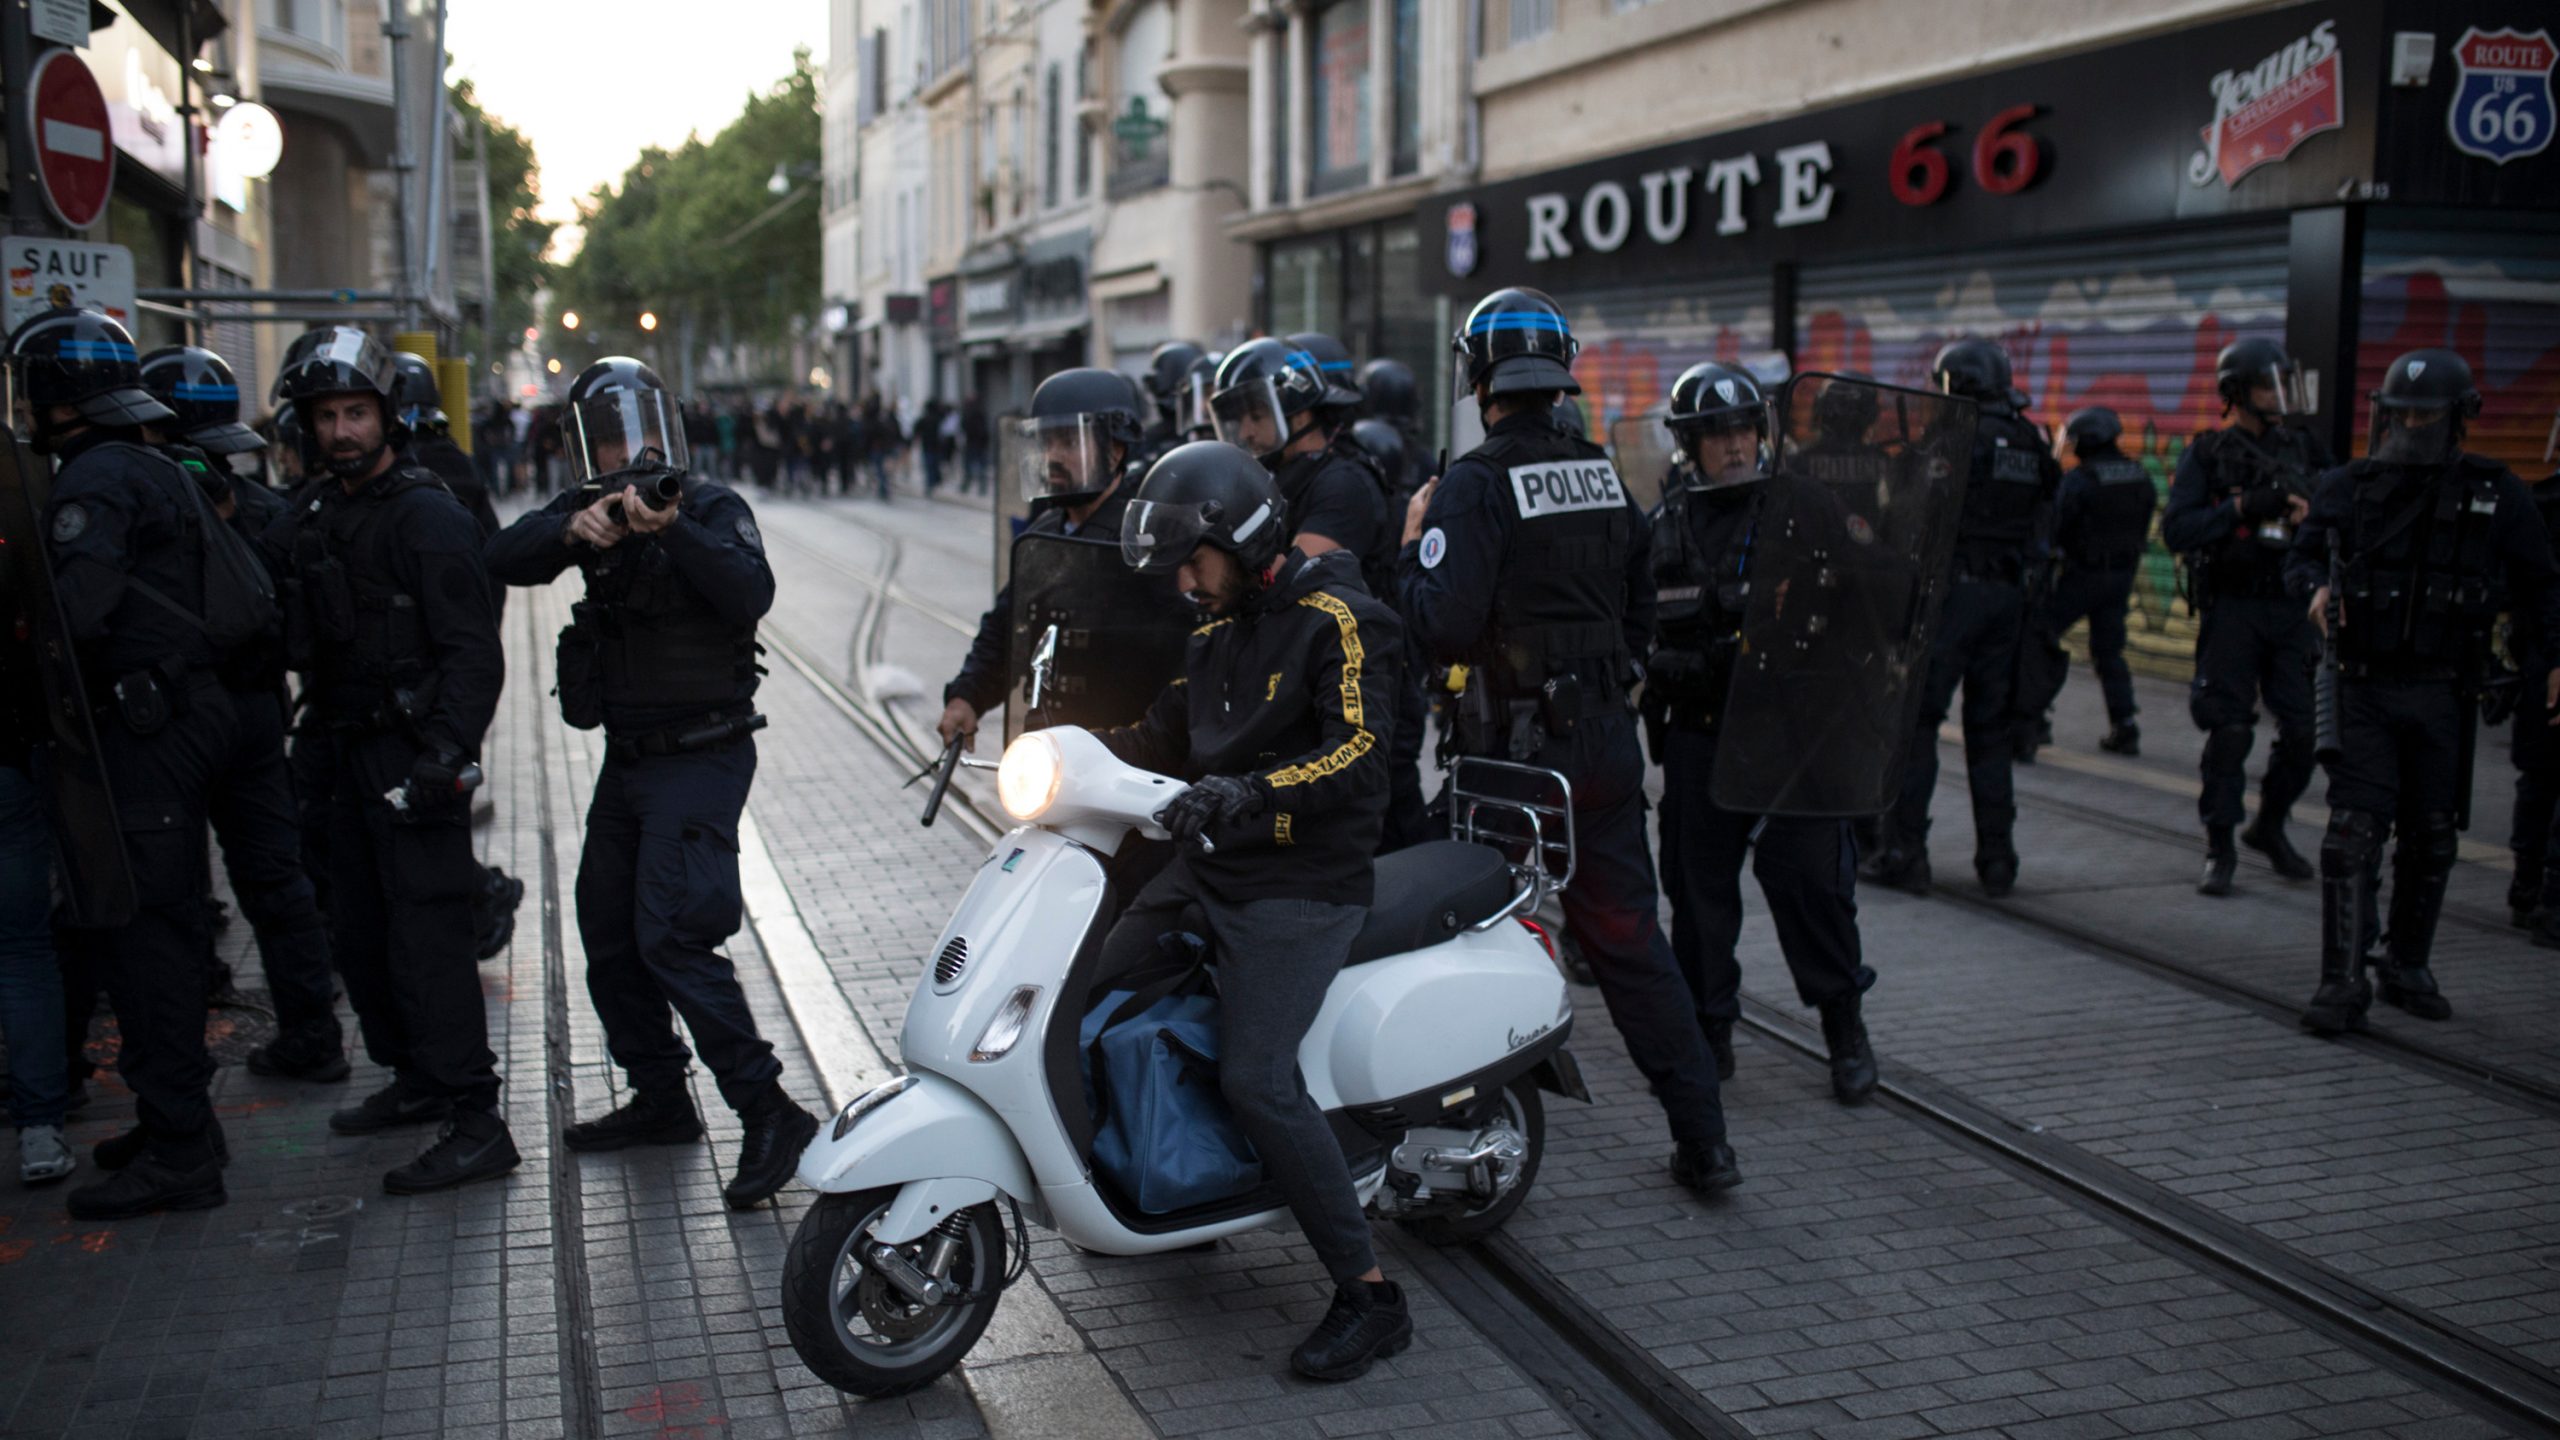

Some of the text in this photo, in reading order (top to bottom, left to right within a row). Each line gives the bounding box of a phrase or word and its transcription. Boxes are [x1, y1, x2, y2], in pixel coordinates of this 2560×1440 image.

[2474, 44, 2543, 67] ROUTE
[2189, 19, 2338, 186] Jeans
[2229, 67, 2328, 130] ORIGINAL
[2492, 75, 2518, 94] US
[2468, 91, 2537, 144] 66
[1525, 139, 1836, 262] ROUTE
[1888, 102, 2040, 207] 66
[1519, 466, 1620, 511] POLICE
